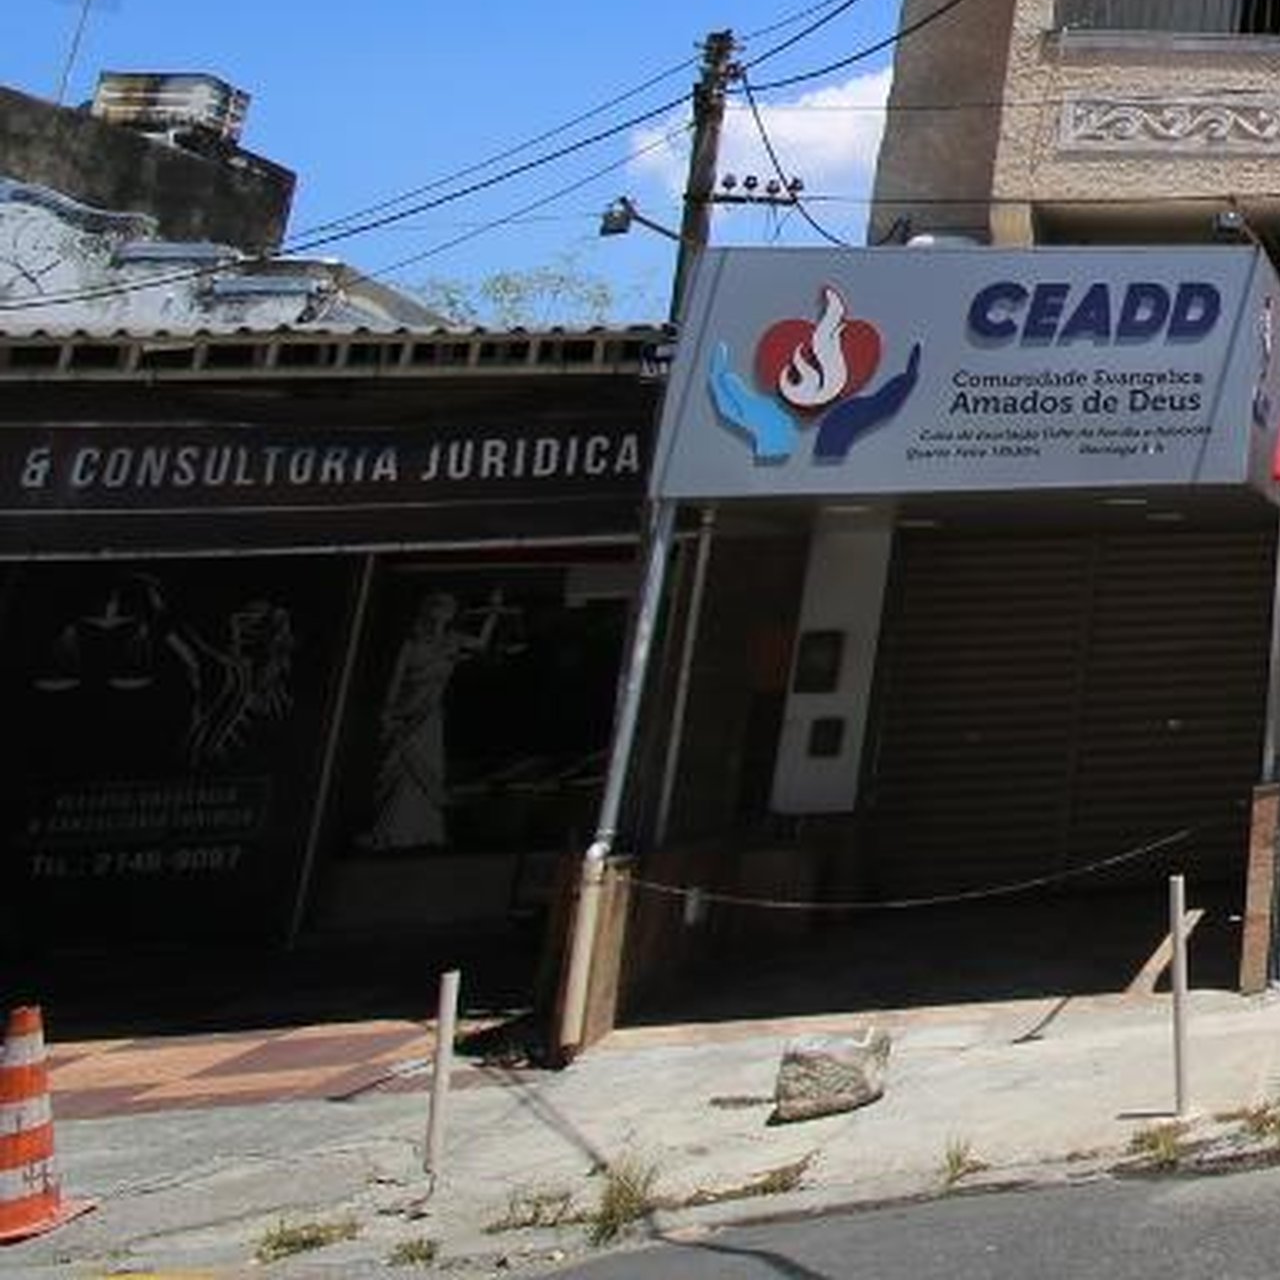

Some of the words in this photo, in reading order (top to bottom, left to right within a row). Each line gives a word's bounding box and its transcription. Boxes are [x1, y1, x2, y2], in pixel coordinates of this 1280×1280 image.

[966, 281, 1222, 344] CEADD
[949, 390, 1075, 416] Amados
[1082, 389, 1119, 414] de
[1128, 388, 1202, 412] Deus
[21, 447, 53, 489] &
[70, 444, 399, 489] CONSULTORIA
[422, 433, 642, 482] JURIDICA
